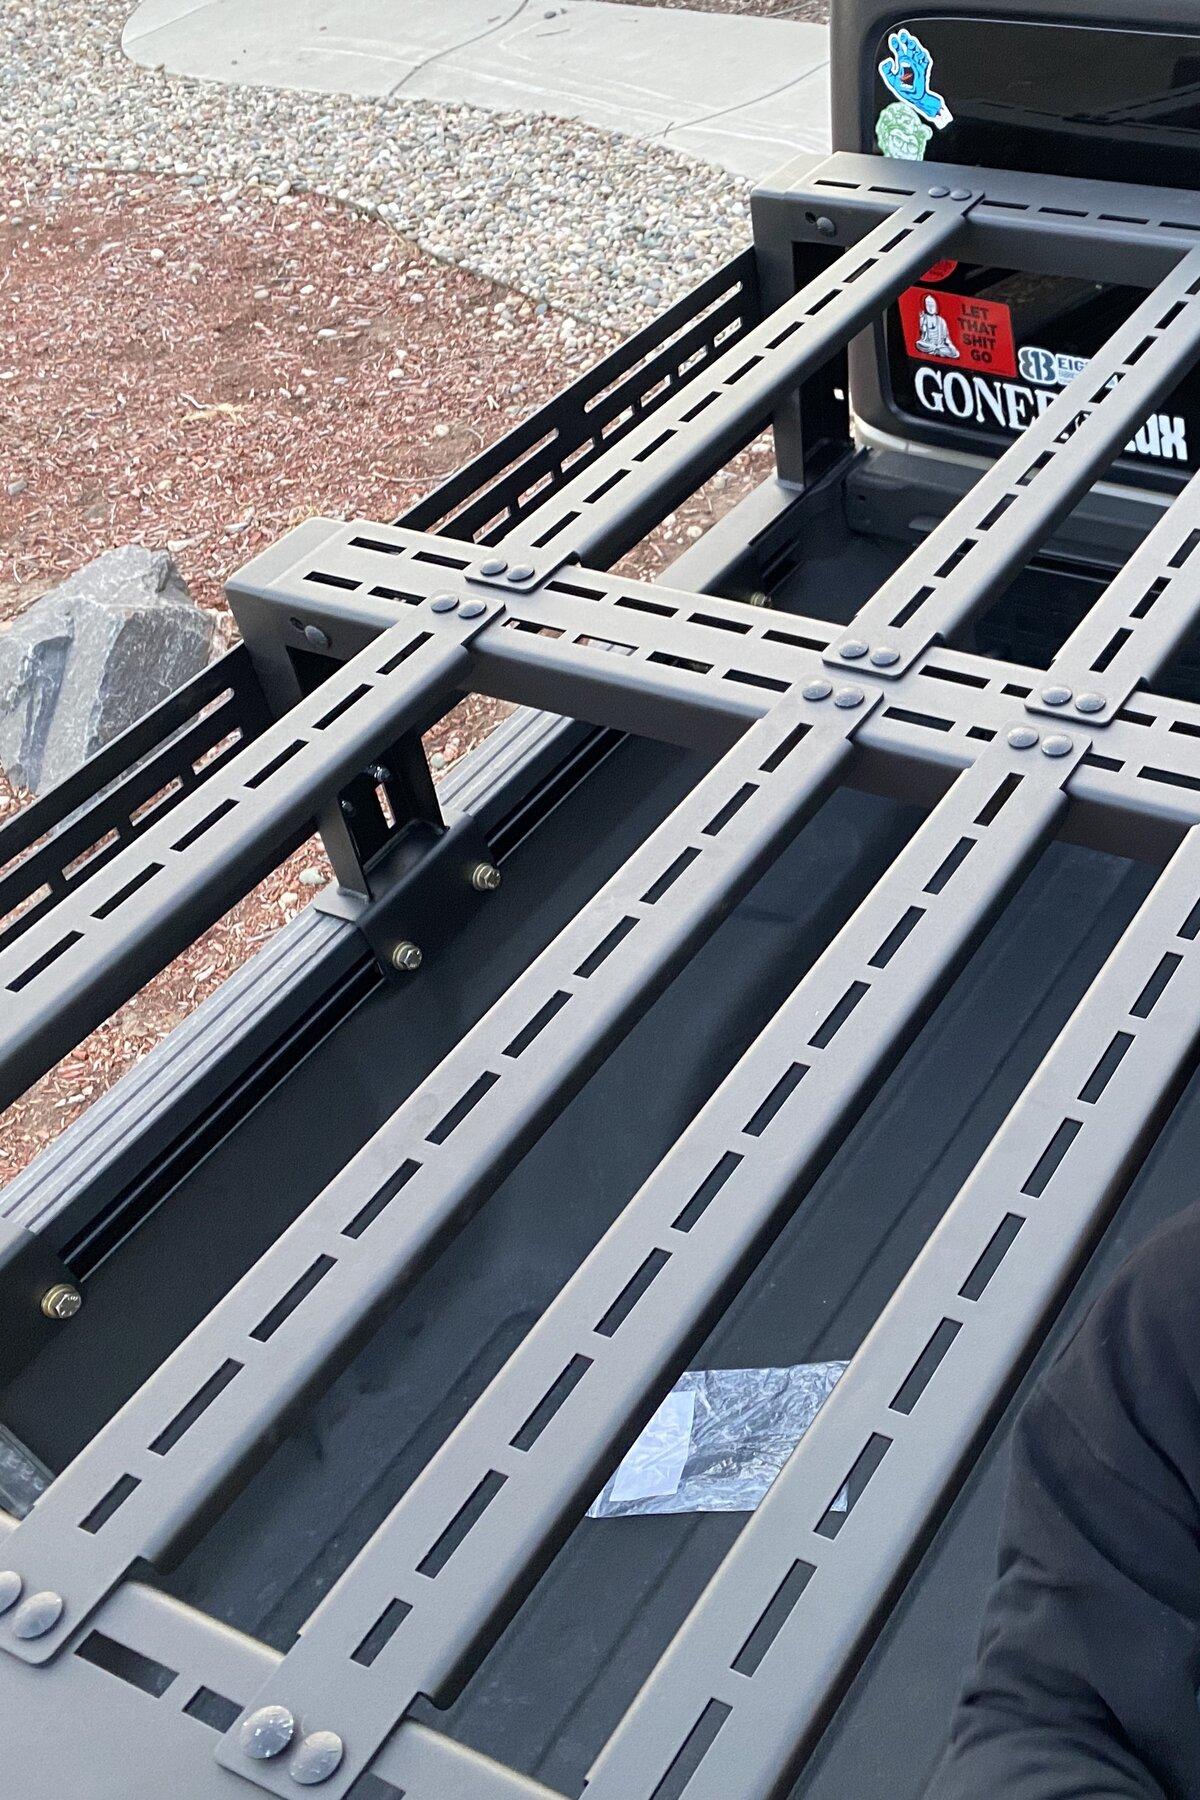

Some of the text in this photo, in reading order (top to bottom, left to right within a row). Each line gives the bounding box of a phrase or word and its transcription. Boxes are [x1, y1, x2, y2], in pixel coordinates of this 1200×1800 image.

[961, 303, 989, 320] LET
[957, 317, 997, 336] THAT
[962, 333, 996, 350] SHIT
[971, 349, 993, 364] GO
[1058, 357, 1089, 371] EIG
